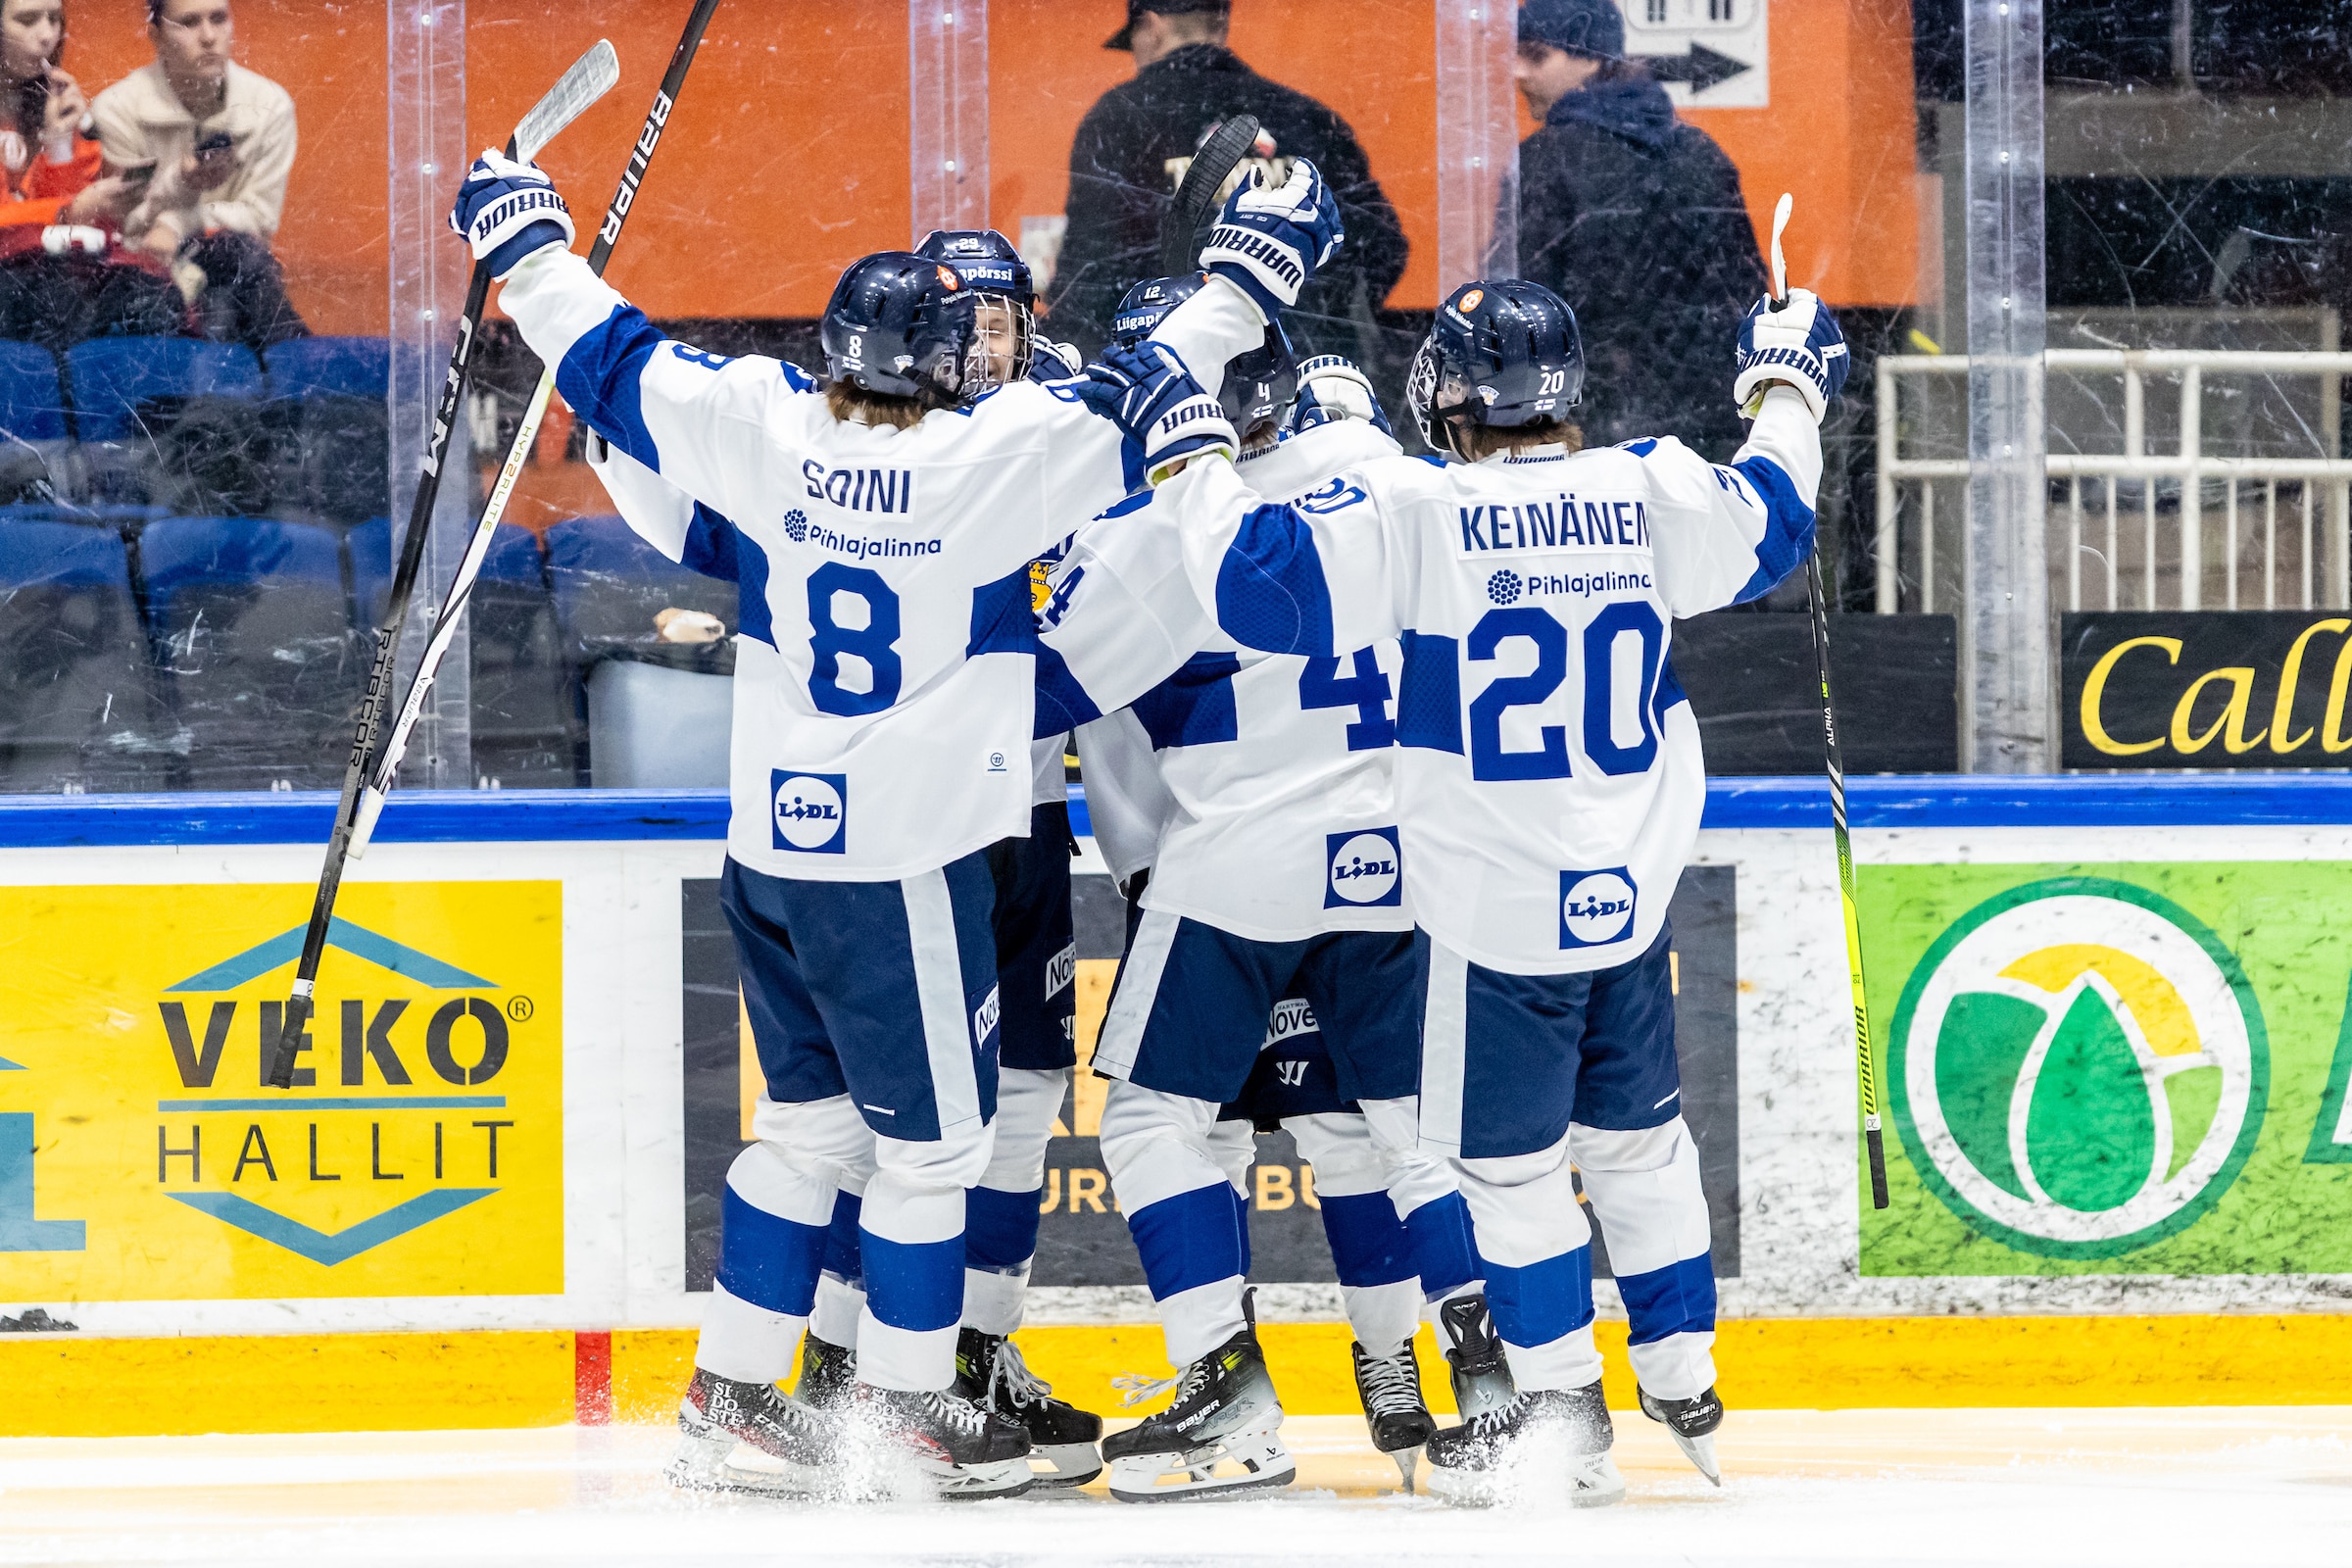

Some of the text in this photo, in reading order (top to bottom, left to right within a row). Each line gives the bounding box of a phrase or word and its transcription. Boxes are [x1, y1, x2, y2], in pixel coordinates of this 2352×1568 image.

[475, 192, 569, 241] ARRIOR
[958, 237, 979, 250] 29
[959, 266, 1013, 282] apörssi
[1144, 285, 1161, 300] 12
[1116, 312, 1164, 332] Liigapö
[849, 334, 862, 359] 8
[1257, 381, 1271, 403] 4
[1538, 369, 1565, 396] 20
[1740, 348, 1830, 401] WARRIO
[423, 315, 473, 478] CCM
[1161, 404, 1224, 434] RIOR
[1502, 454, 1565, 465] WARRIOR
[803, 458, 911, 514] SOINI
[809, 523, 942, 561] Pihlajalinna
[1045, 565, 1085, 627] 4
[1528, 569, 1651, 598] Pihlajalinna
[807, 561, 902, 717] 8
[1298, 645, 1396, 752] 4
[1467, 601, 1664, 781] 20
[1824, 707, 1836, 747] ALPHA
[158, 996, 511, 1090] VEKO
[1854, 1005, 1875, 1115] WARRIOR
[158, 1120, 514, 1184] HALLIT
[710, 1395, 738, 1412] DO
[713, 1381, 732, 1398] SI
[1176, 1398, 1221, 1434] BAUER
